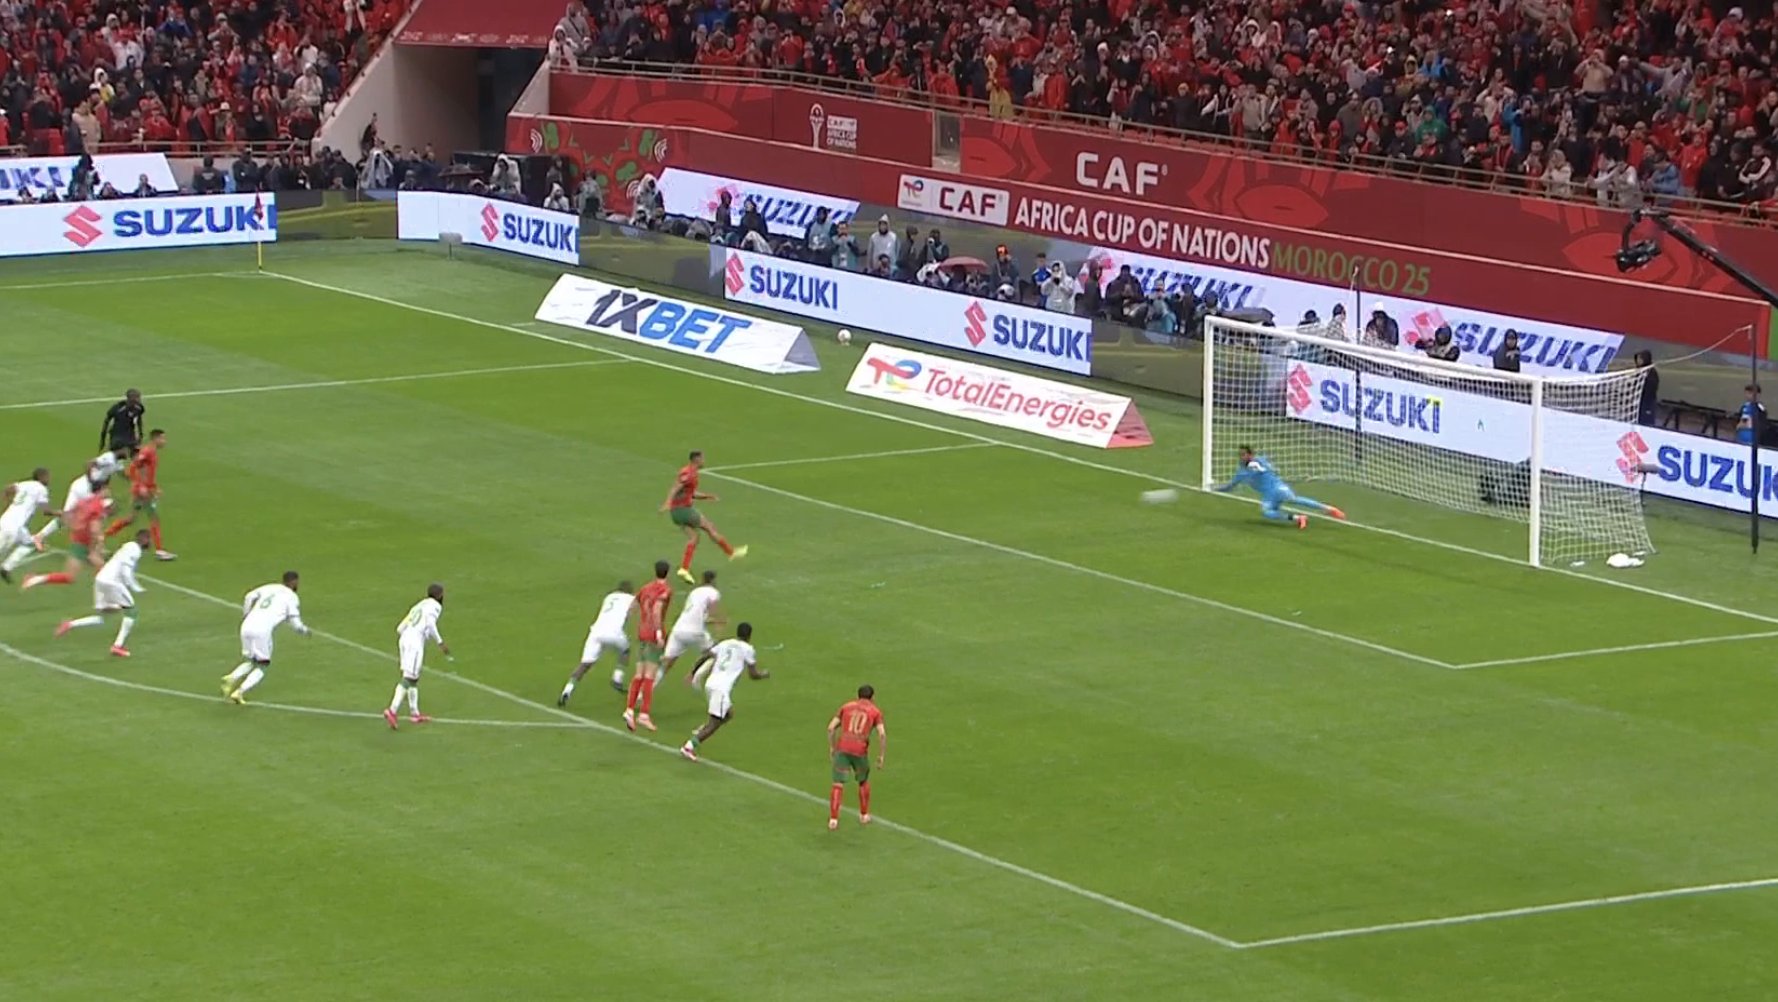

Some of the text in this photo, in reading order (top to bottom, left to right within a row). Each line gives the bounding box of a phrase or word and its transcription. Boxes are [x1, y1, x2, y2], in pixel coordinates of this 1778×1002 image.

[113, 204, 277, 238] SUZUKI
[503, 212, 580, 256] SUZUKI
[1015, 197, 1431, 296] AFRICA CUP OF NATIONS MOROCCO 25
[750, 264, 838, 310] SUZUKI
[585, 289, 753, 354] 1XBET
[993, 304, 1093, 363] SUZUKI
[924, 367, 1112, 430] TotalEnergies
[1320, 379, 1440, 434] SUZUKI
[260, 593, 275, 609] 6
[848, 708, 868, 734] 10
